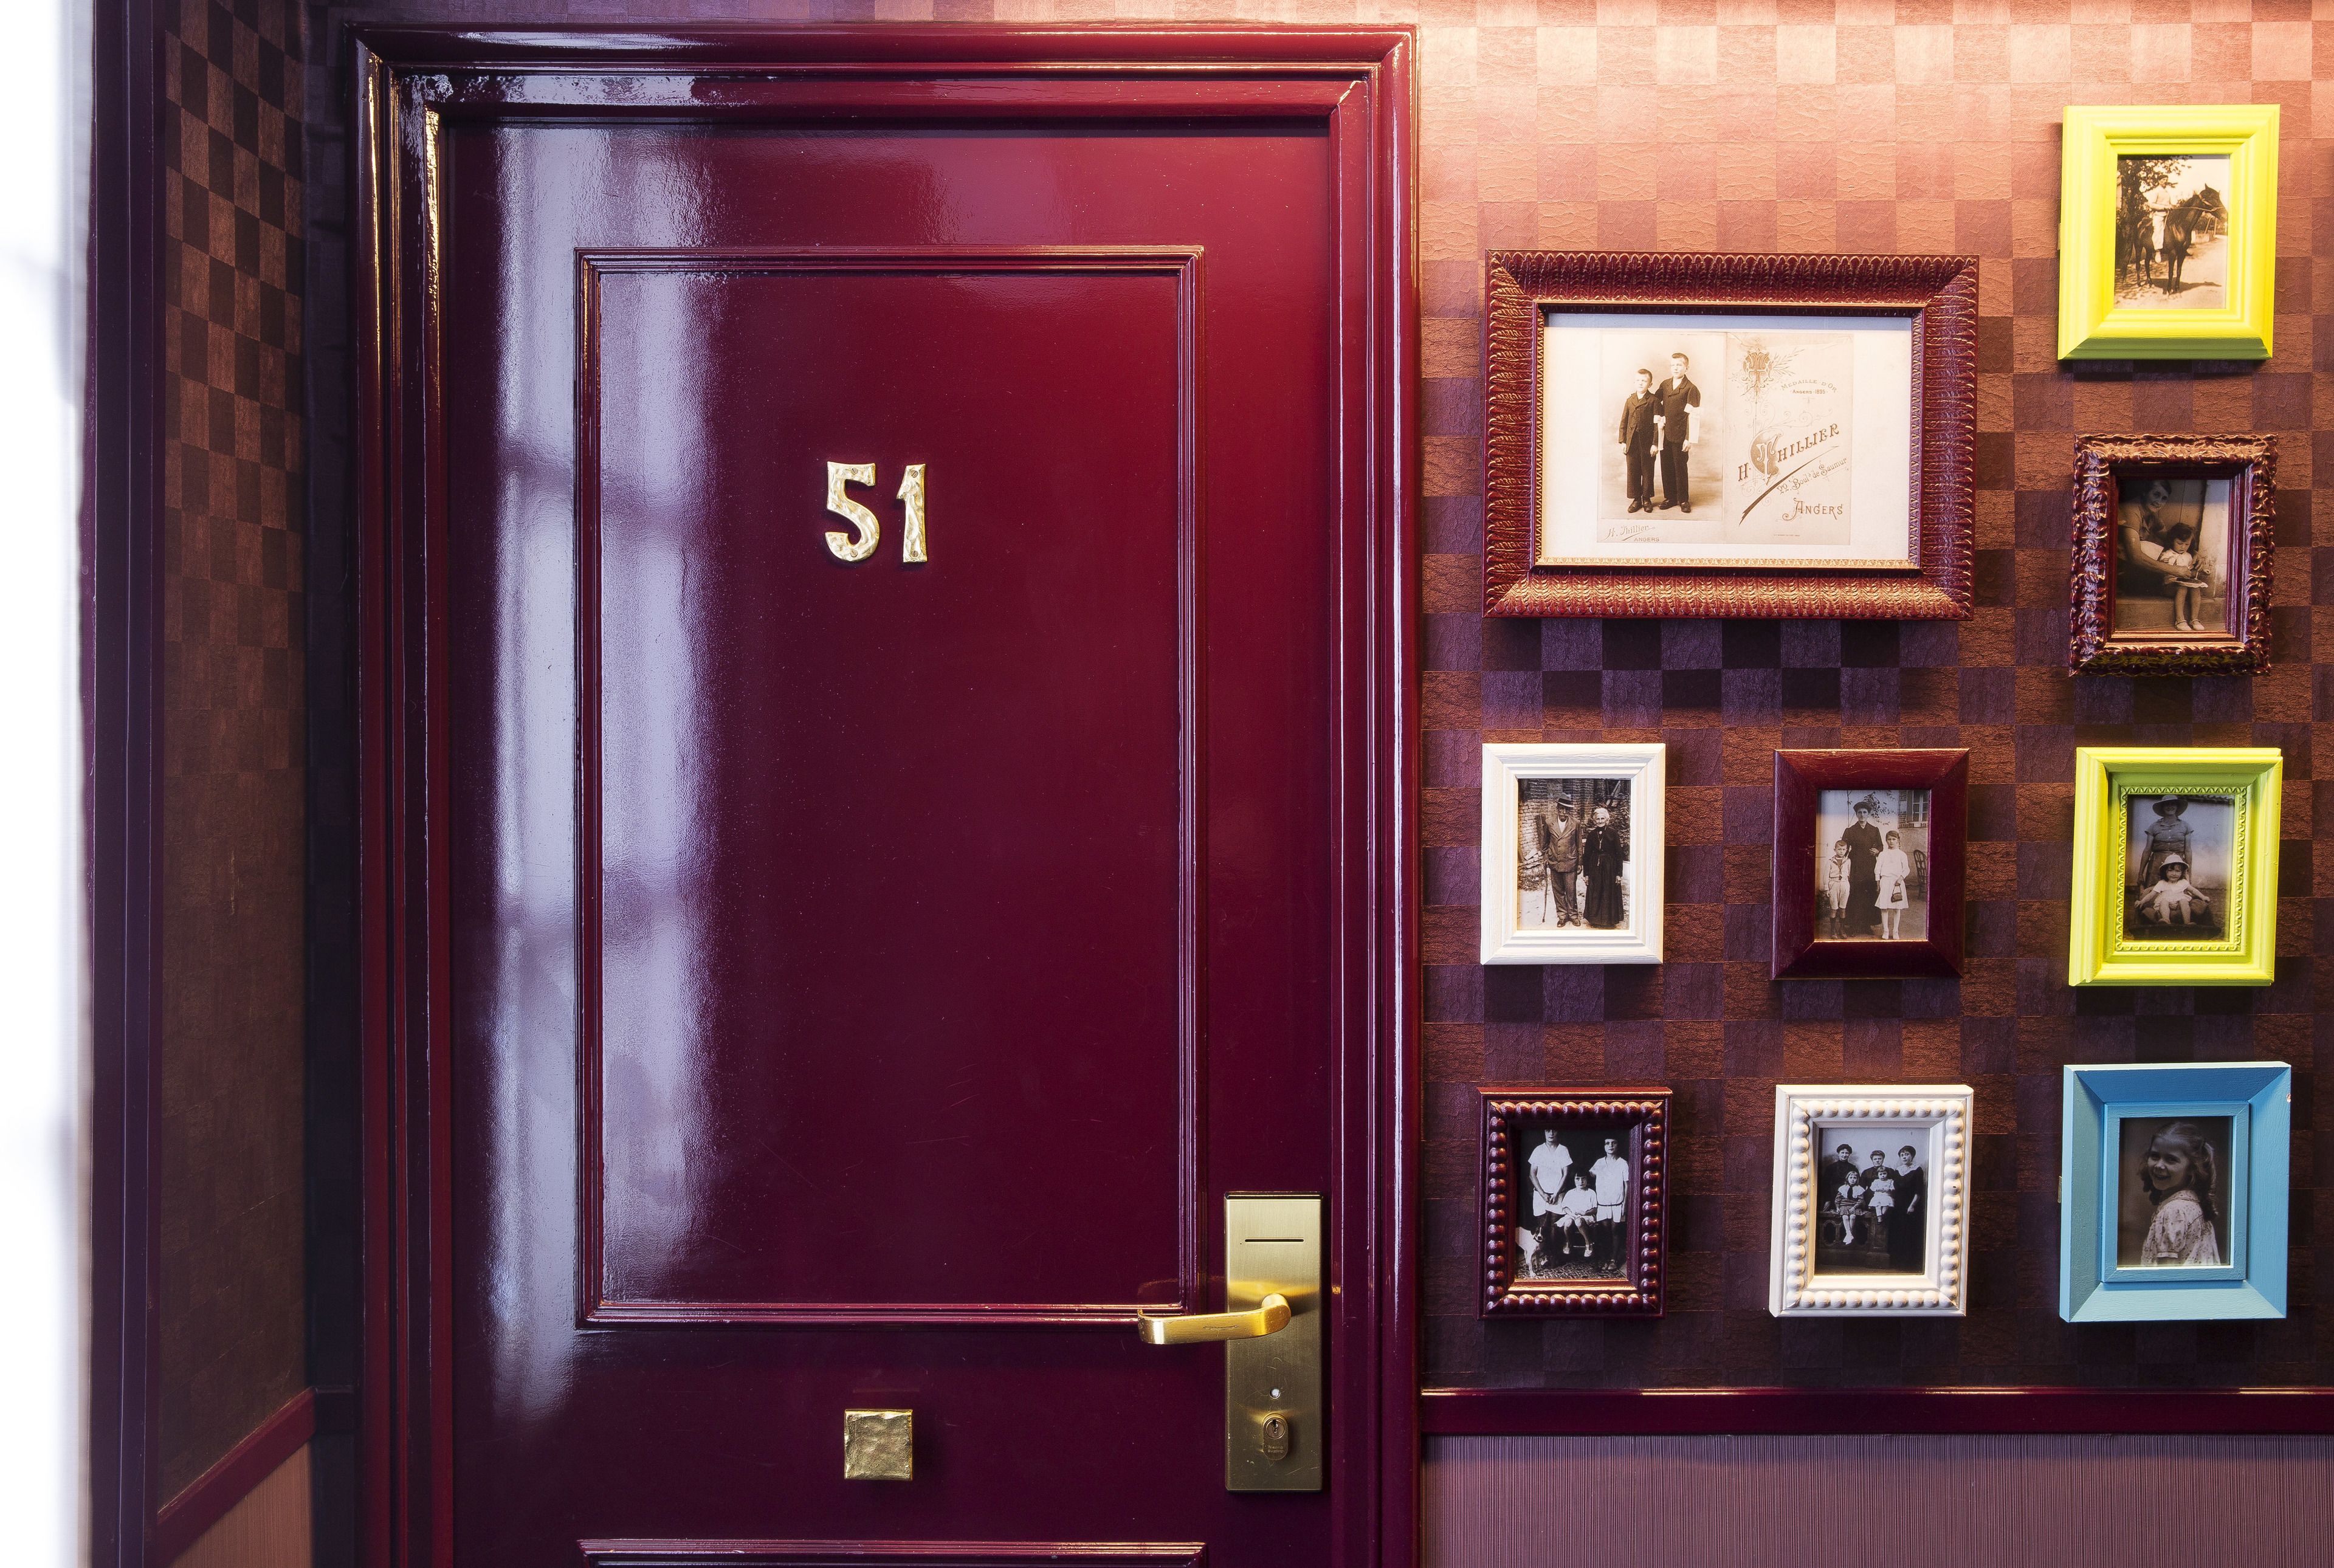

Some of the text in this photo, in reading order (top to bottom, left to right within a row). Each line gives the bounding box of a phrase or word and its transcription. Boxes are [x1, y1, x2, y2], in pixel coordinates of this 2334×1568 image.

[1755, 423, 1839, 483] THILLIER
[1812, 469, 1820, 478] de
[1819, 458, 1847, 476] Saumur
[825, 461, 928, 563] 51
[1782, 497, 1843, 521] ANGERS
